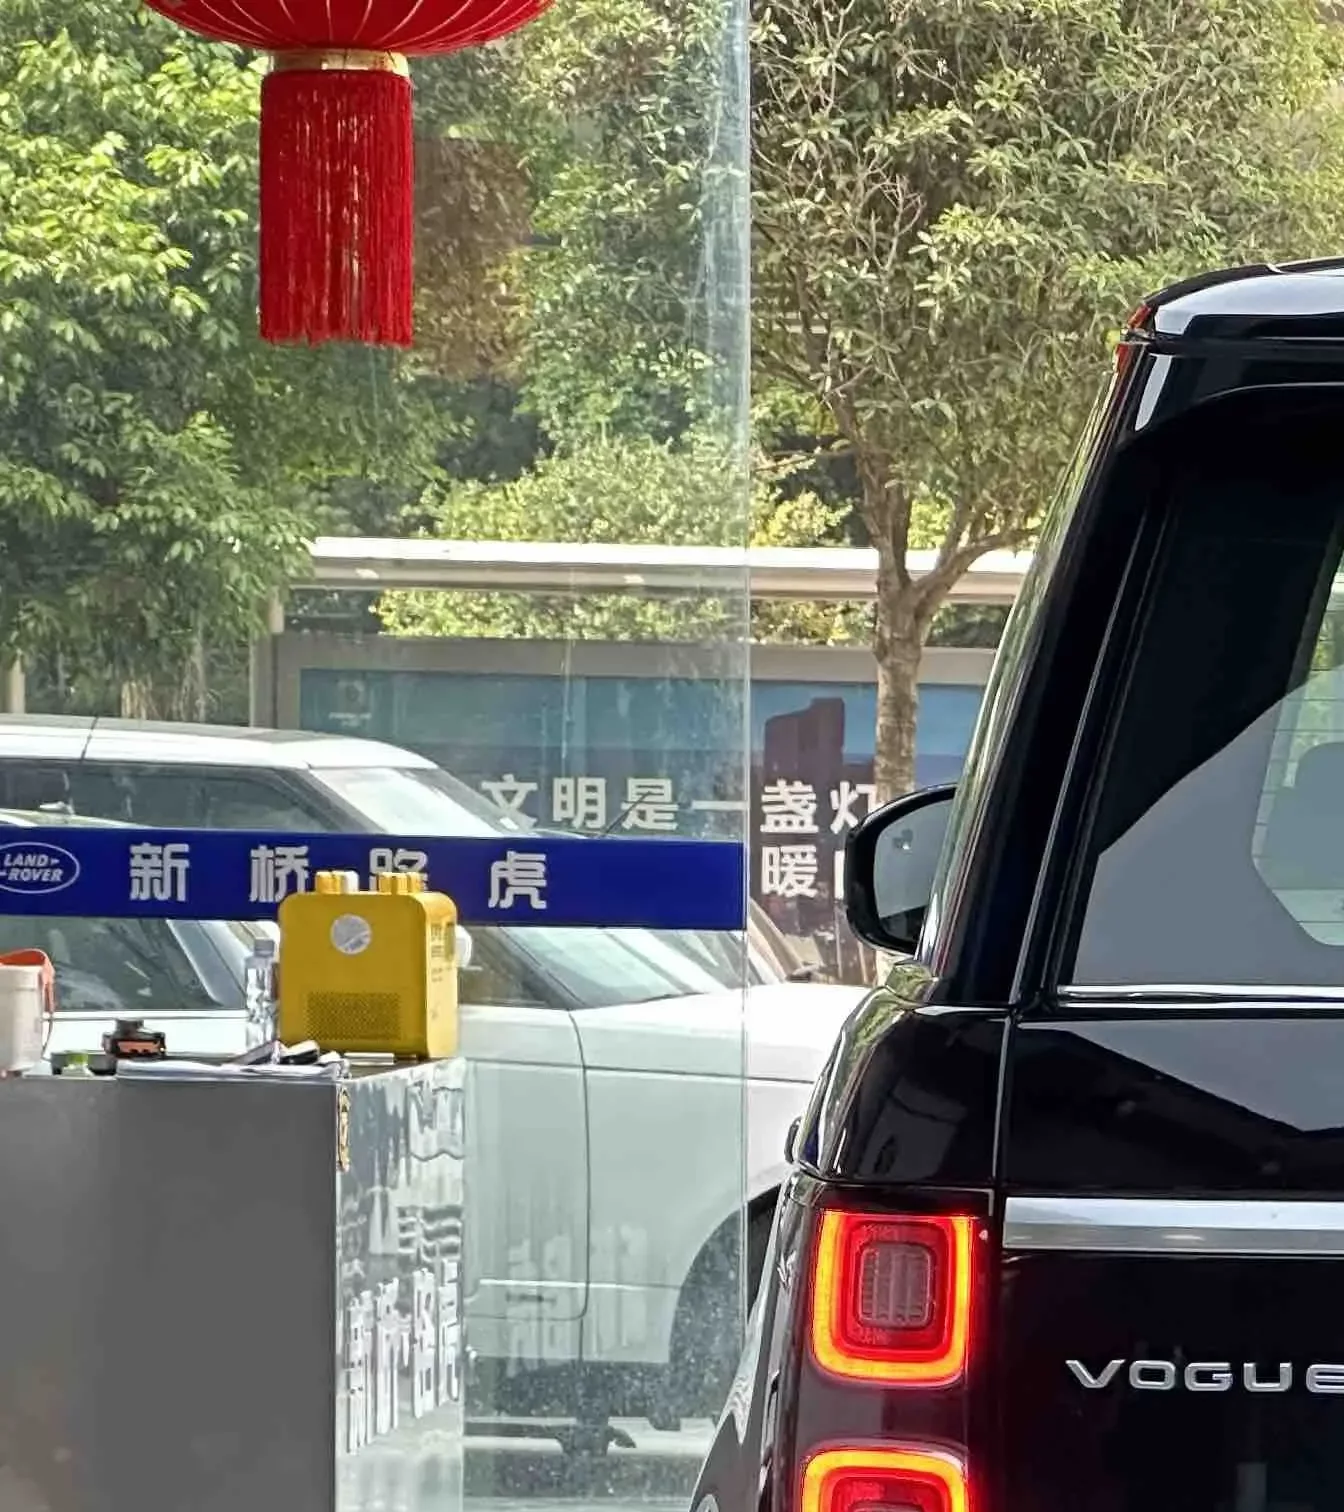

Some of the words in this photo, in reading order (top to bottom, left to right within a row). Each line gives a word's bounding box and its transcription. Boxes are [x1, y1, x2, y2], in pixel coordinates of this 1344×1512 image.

[4, 853, 49, 867] LAND
[8, 867, 63, 882] ROVER
[761, 846, 845, 898] 暖
